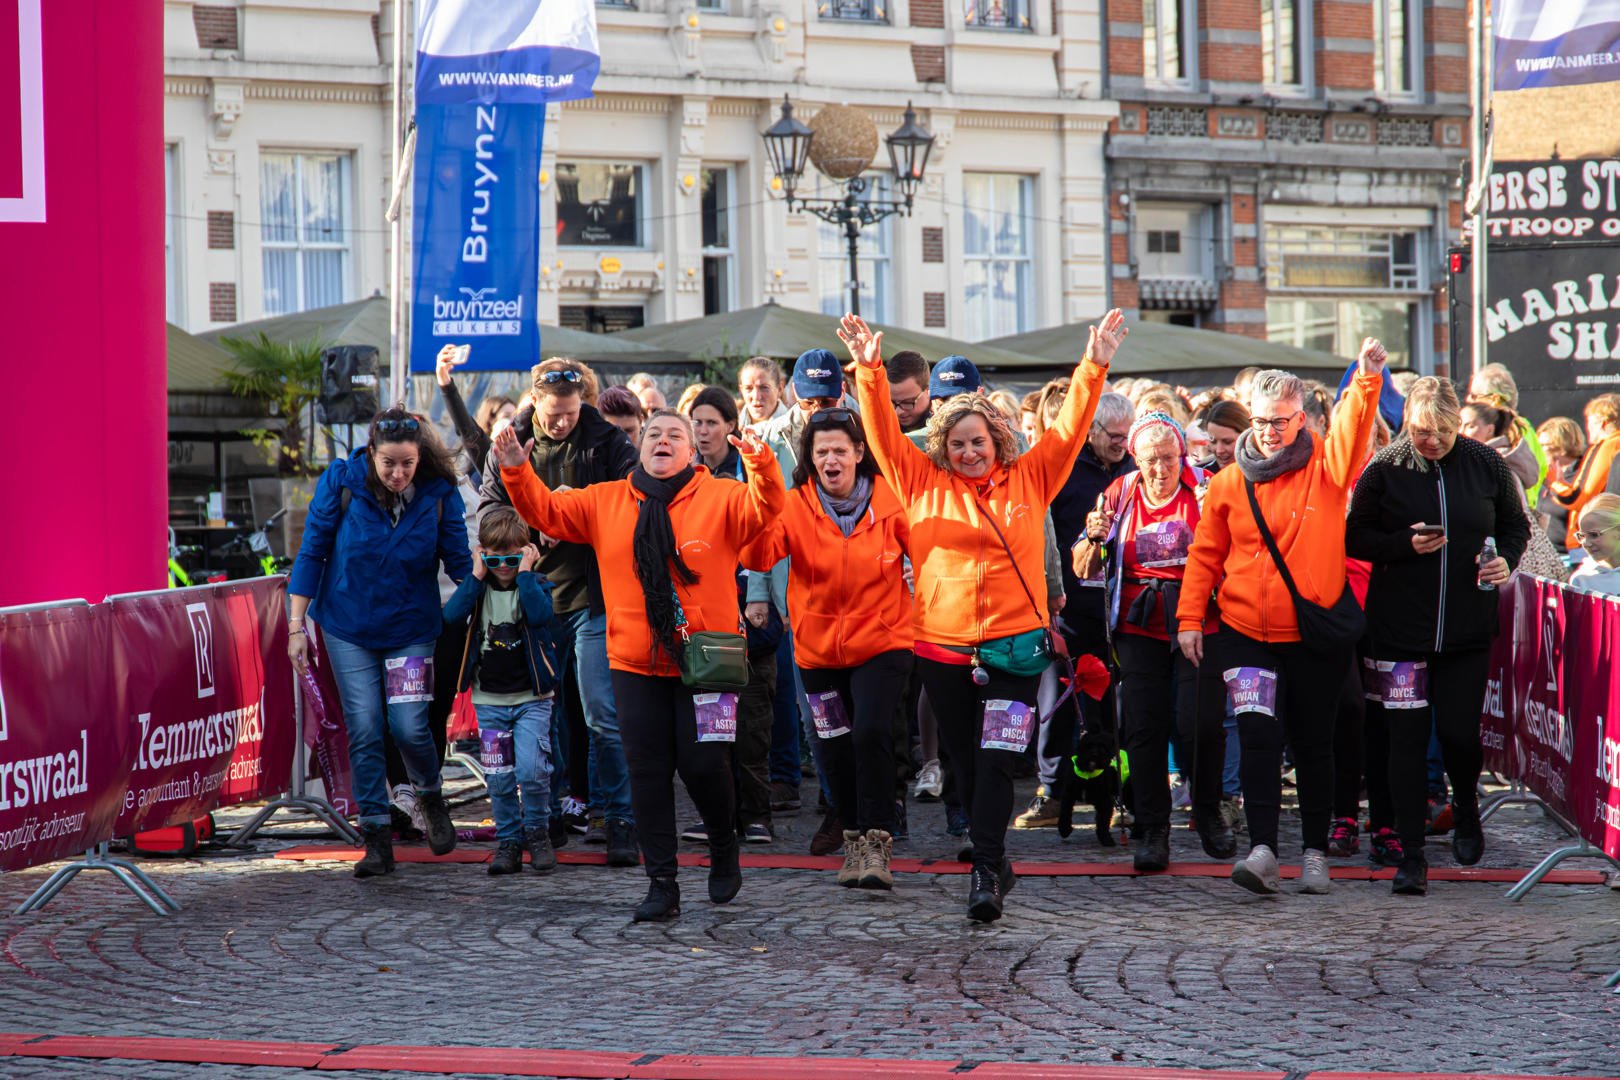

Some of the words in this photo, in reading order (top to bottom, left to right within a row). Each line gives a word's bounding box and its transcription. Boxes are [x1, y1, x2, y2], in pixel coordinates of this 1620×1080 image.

[1484, 165, 1568, 213] ERSE
[434, 294, 522, 321] bruynzeel
[433, 321, 520, 334] KEUKENS
[407, 668, 420, 679] 107
[403, 680, 425, 692] ALICE
[1240, 679, 1251, 689] 92
[1389, 687, 1415, 698] JOYCE
[40, 808, 86, 841] adviseur
